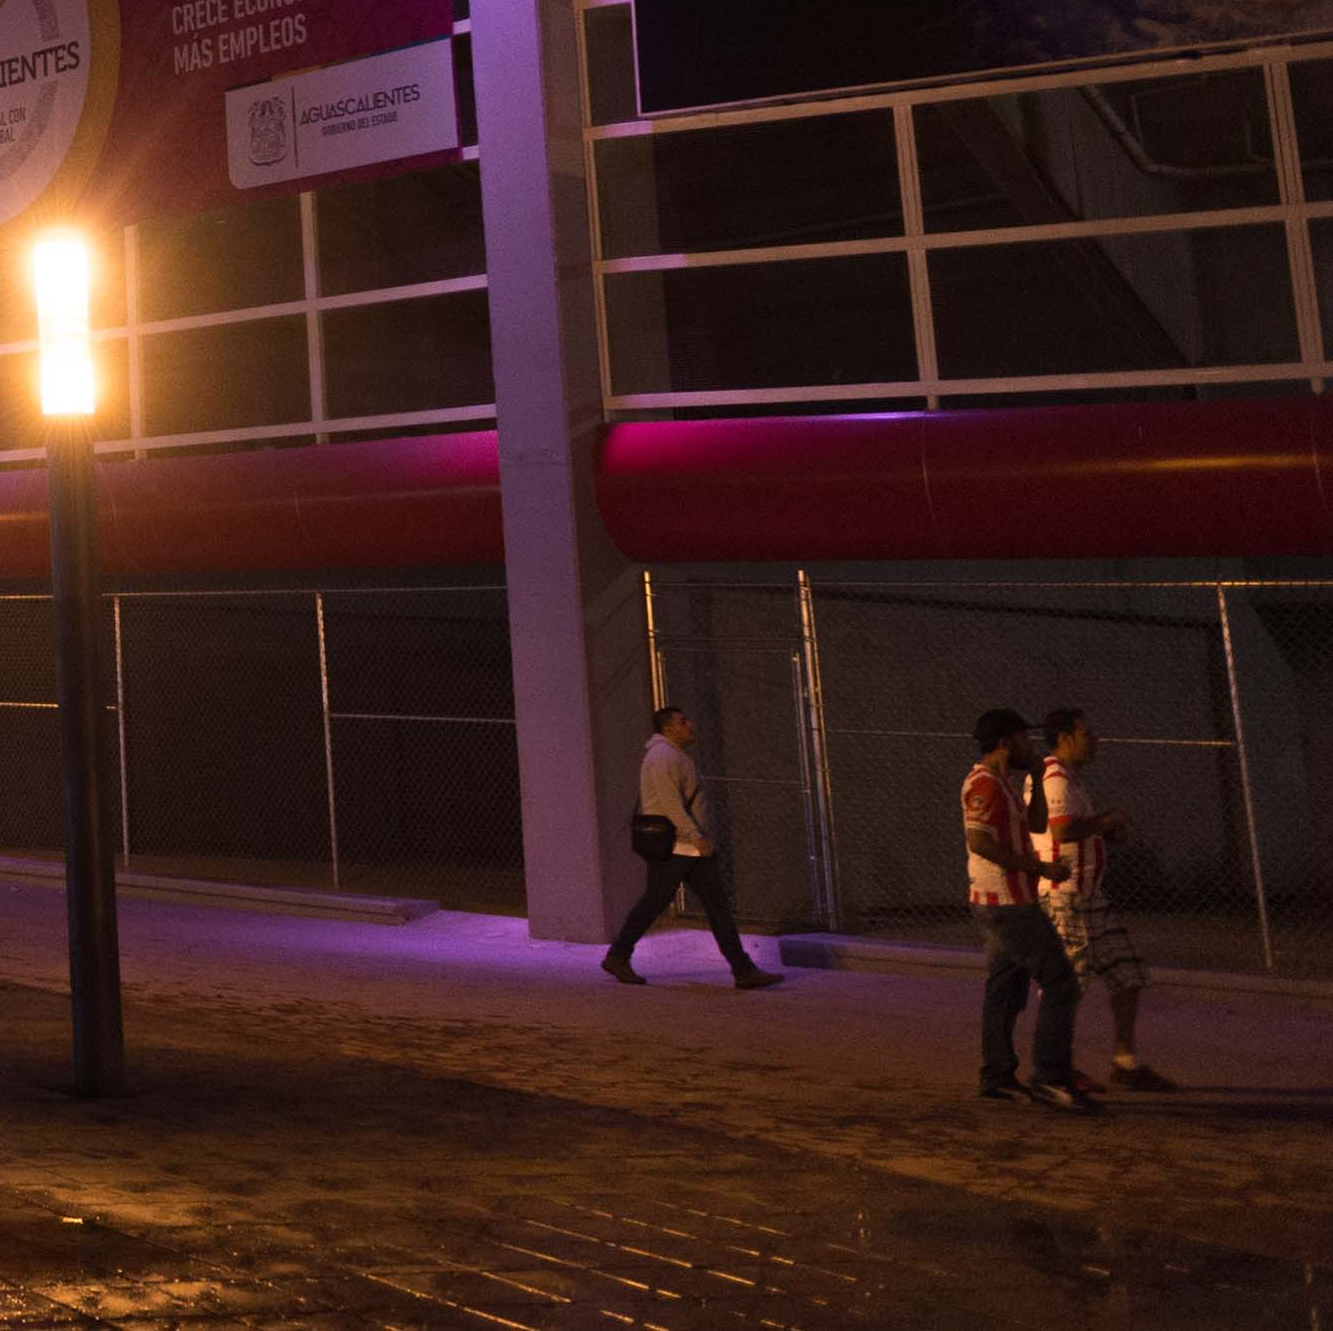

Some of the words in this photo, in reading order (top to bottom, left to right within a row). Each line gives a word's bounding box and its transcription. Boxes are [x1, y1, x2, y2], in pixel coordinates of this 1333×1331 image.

[173, 32, 214, 75] MÁS
[218, 13, 307, 63] EMPLEOS
[8, 106, 27, 125] CON
[300, 84, 420, 125] AGUASCALIENTES
